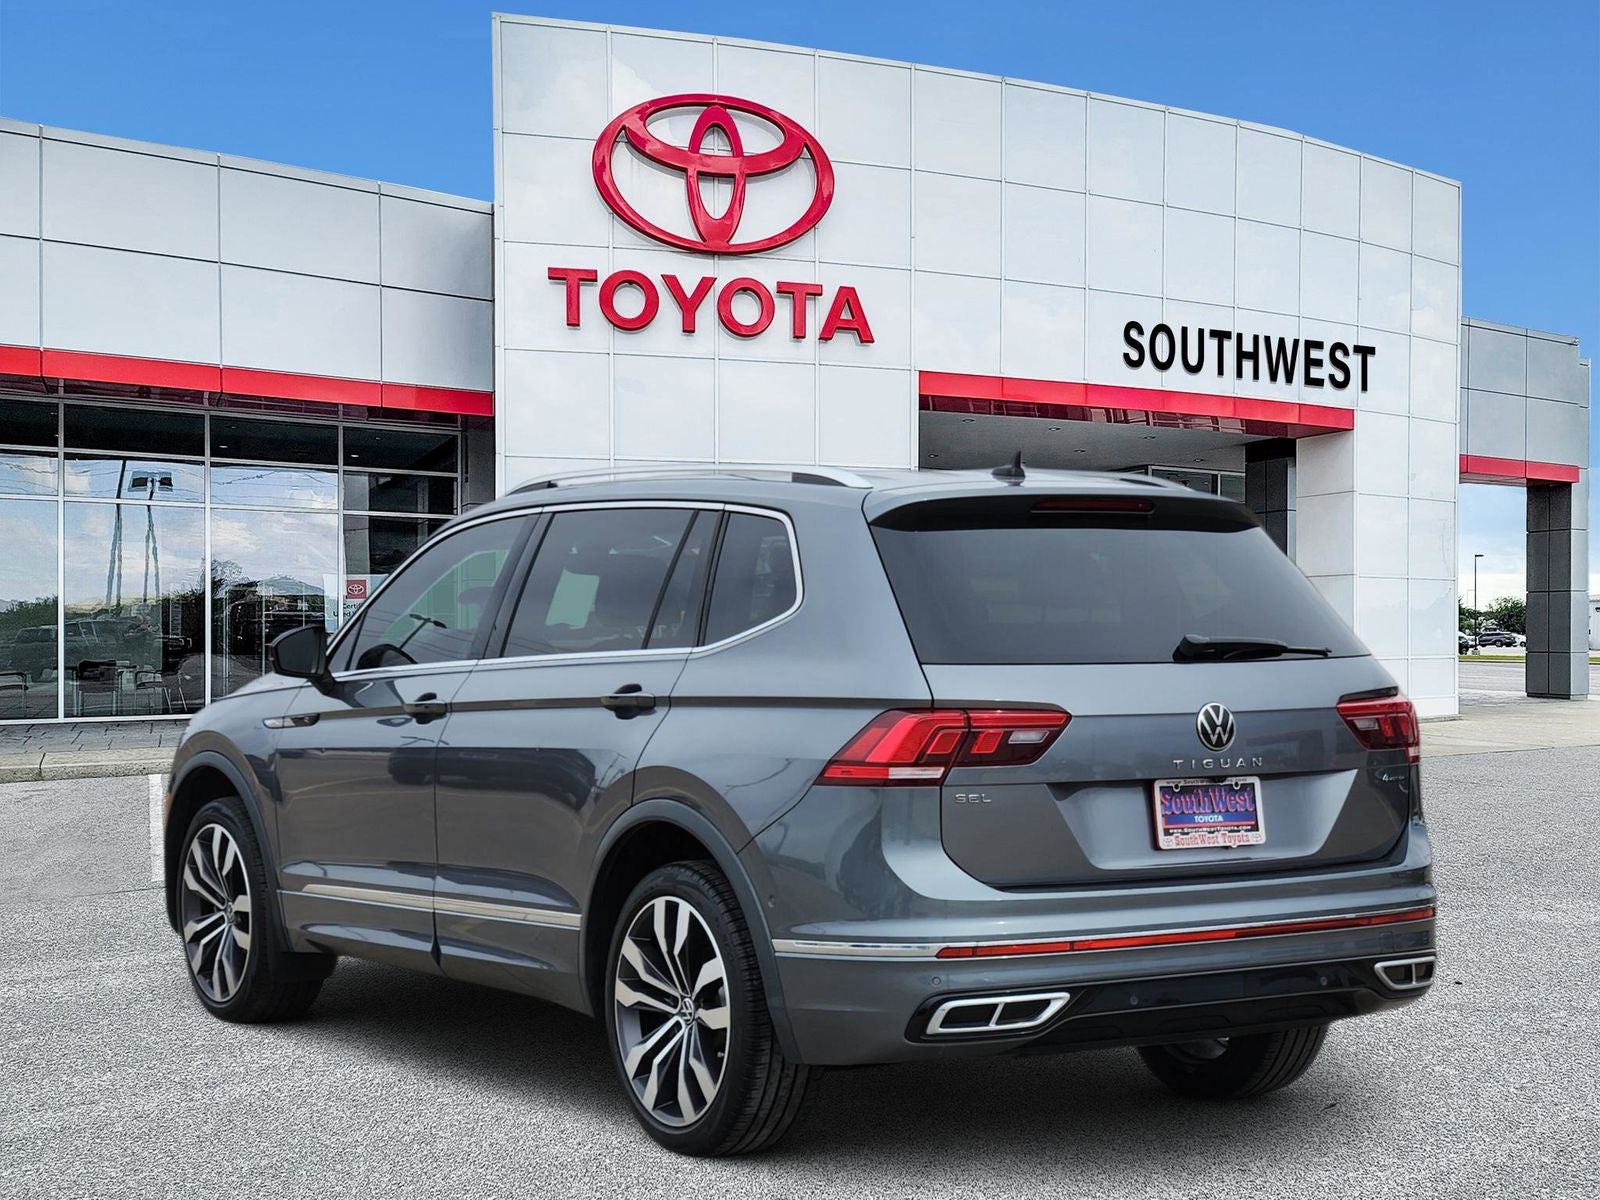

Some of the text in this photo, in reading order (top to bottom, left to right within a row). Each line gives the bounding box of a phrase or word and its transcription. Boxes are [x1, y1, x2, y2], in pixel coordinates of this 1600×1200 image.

[548, 266, 875, 343] TOYOTA
[1122, 320, 1376, 392] SOUTHWEST
[1172, 757, 1264, 769] TIGUAN
[955, 793, 992, 803] SEL
[1160, 787, 1256, 815] SouthWest
[1194, 815, 1224, 823] TOYOTA
[1221, 832, 1250, 845] Toyota
